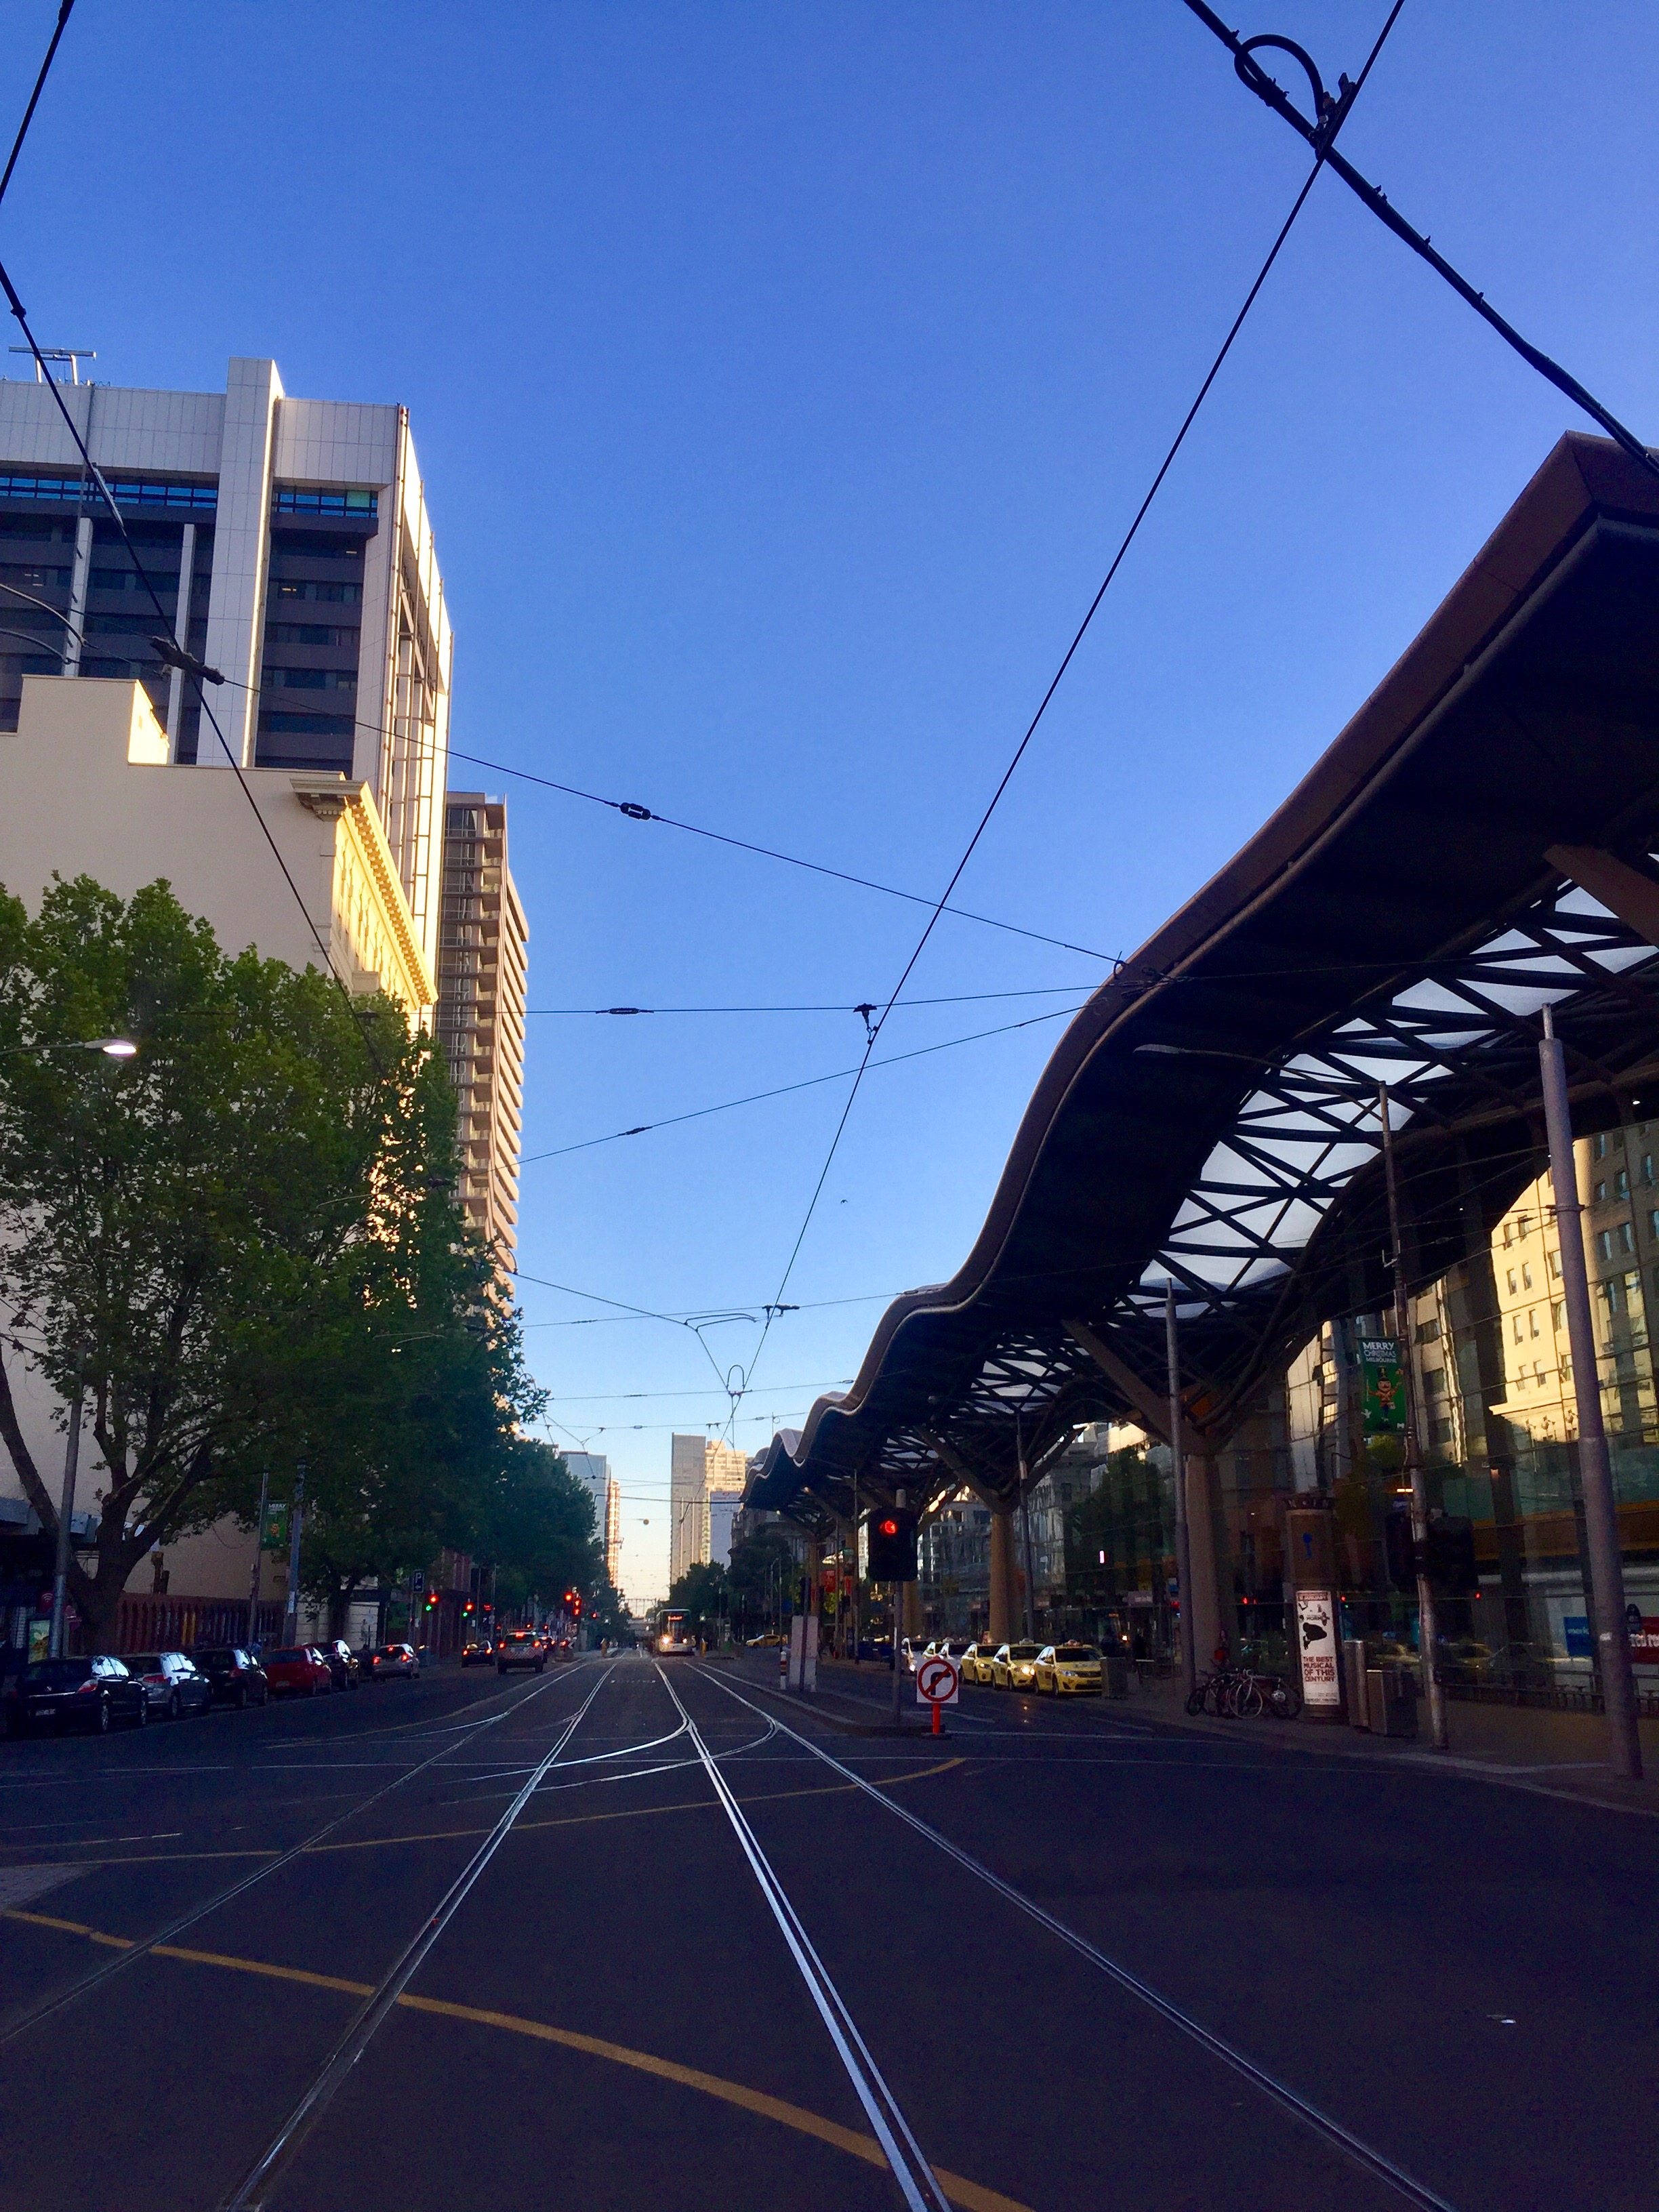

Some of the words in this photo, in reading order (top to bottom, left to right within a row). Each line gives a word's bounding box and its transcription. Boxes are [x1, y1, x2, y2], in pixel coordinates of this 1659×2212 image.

[1362, 1342, 1395, 1351] MERRY
[1364, 1350, 1396, 1358] CHRISTMAS
[415, 1572, 422, 1584] P
